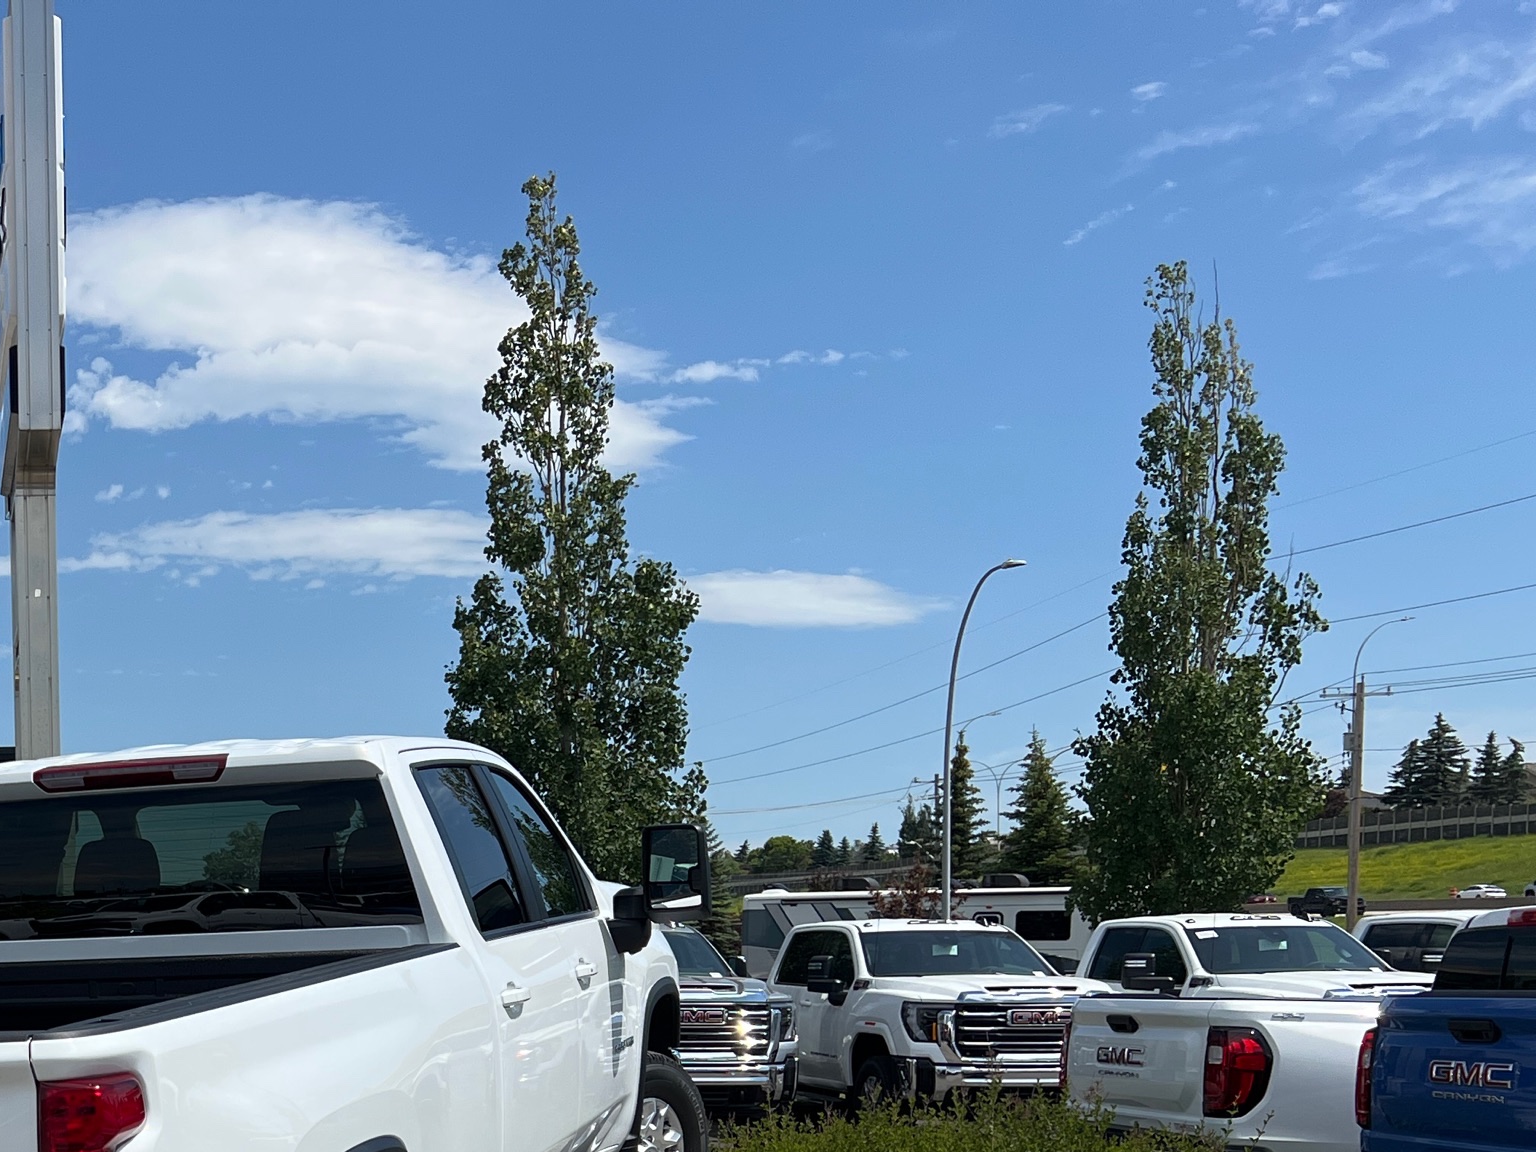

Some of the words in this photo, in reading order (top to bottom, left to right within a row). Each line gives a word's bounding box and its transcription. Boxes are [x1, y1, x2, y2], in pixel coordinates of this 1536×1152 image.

[679, 1010, 724, 1022] MC
[1012, 1011, 1073, 1024] GMC
[1097, 1046, 1145, 1066] GMC
[1428, 1060, 1514, 1088] GMC
[1431, 1090, 1505, 1104] CANYON
